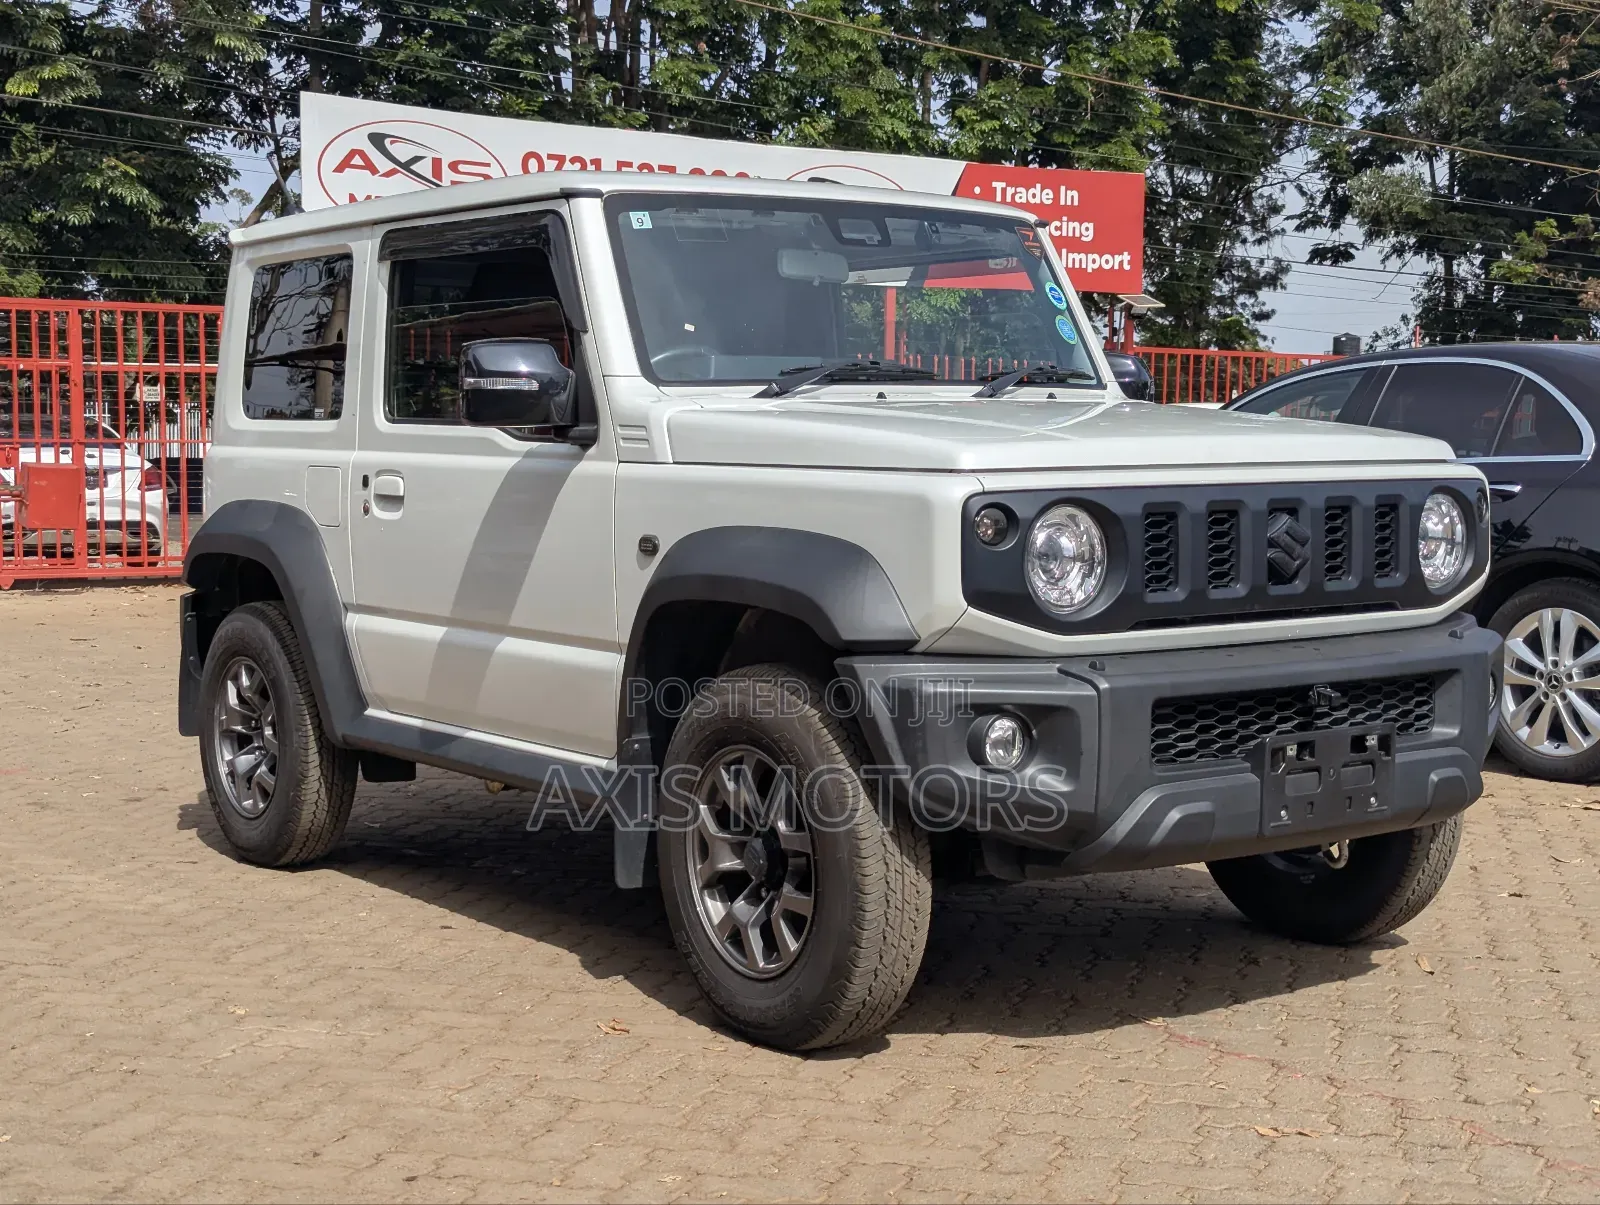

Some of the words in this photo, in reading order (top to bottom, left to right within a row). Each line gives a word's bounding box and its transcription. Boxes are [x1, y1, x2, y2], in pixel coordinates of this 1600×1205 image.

[332, 132, 494, 188] AXIS
[992, 181, 1054, 205] Trade
[1059, 185, 1079, 206] In
[1046, 216, 1094, 242] cing
[1061, 248, 1131, 273] Import
